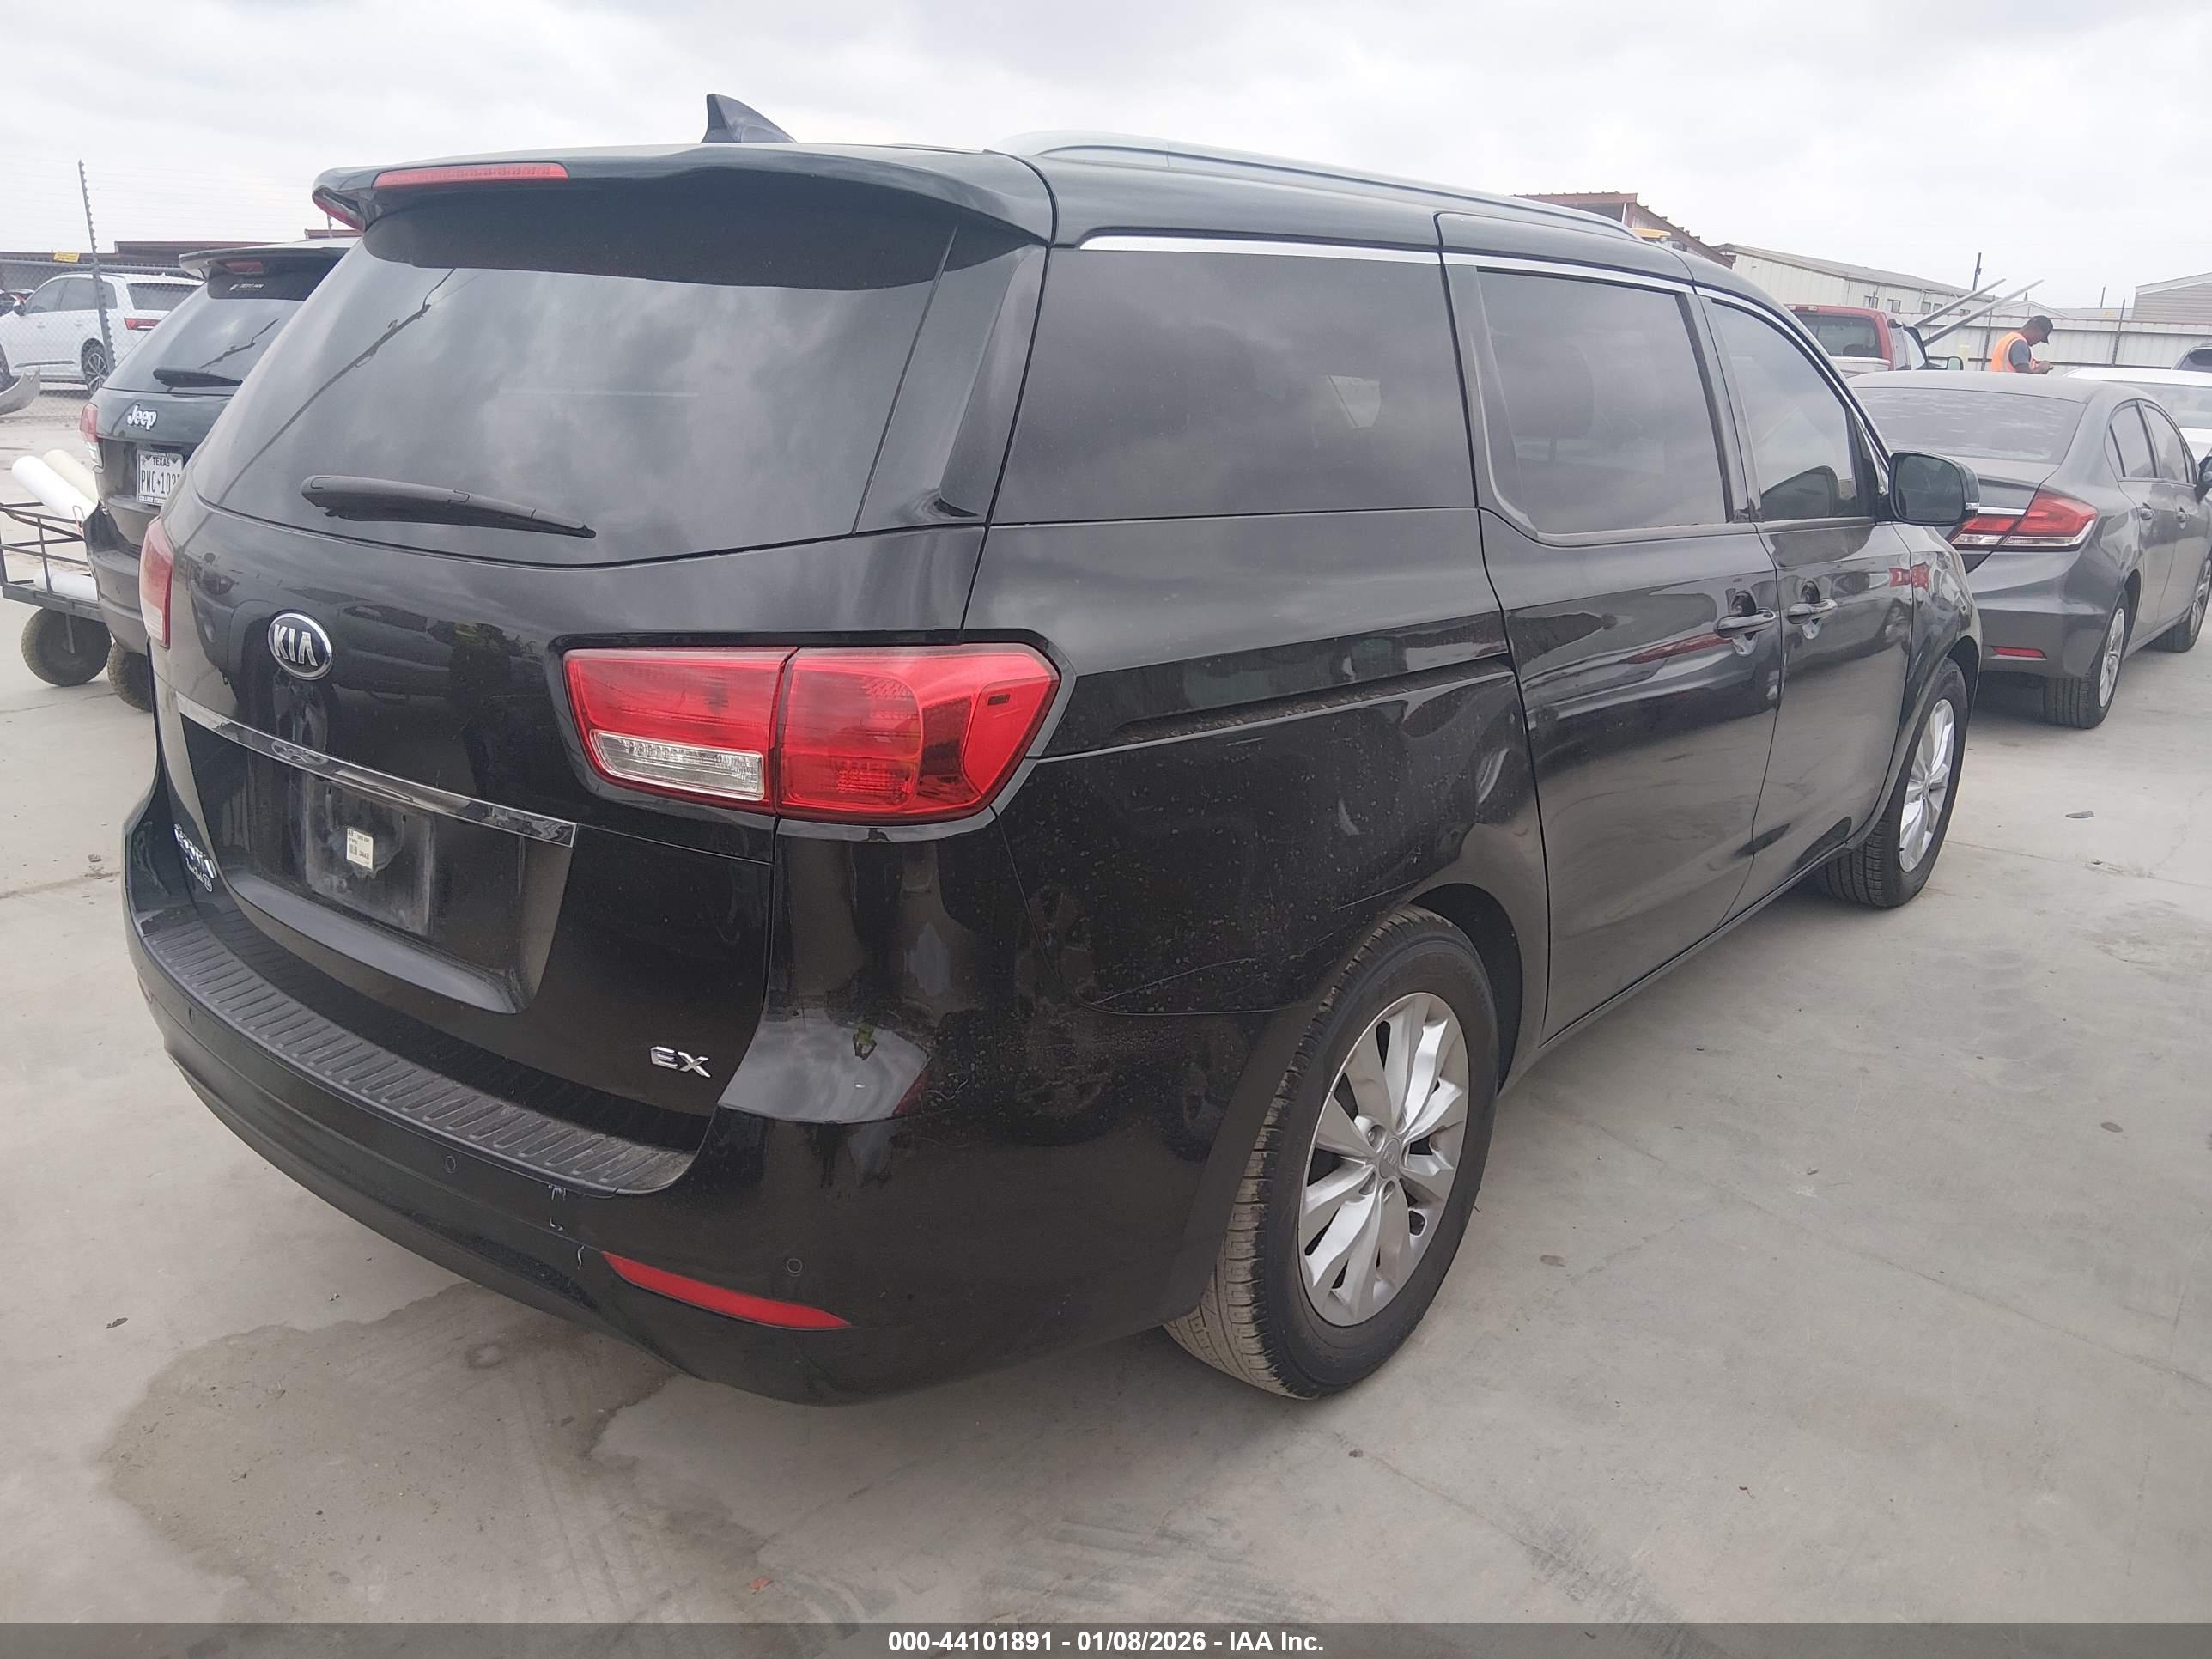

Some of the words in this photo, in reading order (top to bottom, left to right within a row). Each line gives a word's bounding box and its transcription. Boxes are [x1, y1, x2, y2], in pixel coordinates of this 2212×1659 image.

[127, 404, 157, 430] Jeep
[152, 456, 171, 467] TEXAS
[274, 623, 318, 667] KIA
[650, 1046, 711, 1078] EX
